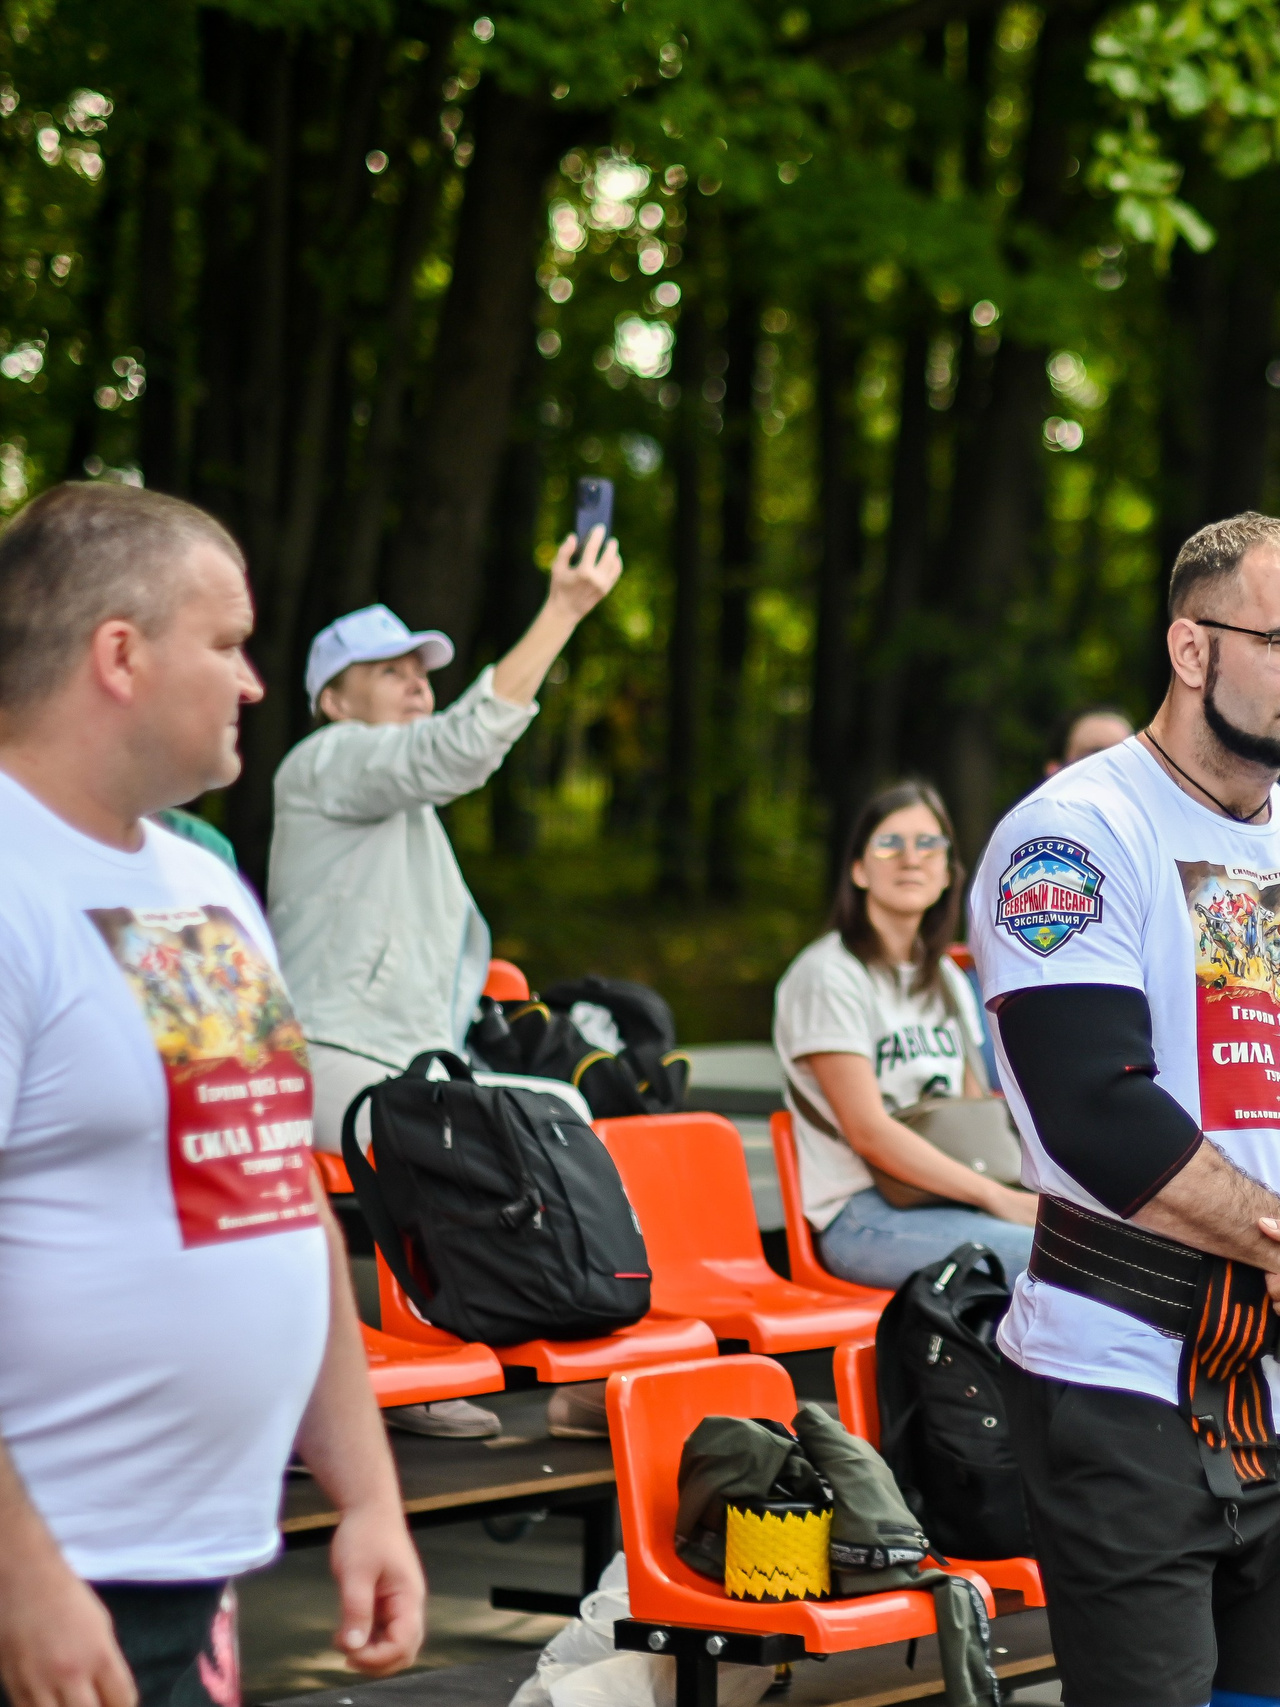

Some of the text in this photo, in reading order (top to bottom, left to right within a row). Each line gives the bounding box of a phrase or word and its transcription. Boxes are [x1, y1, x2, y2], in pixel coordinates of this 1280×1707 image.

[1020, 842, 1075, 857] РОССИЯ
[1004, 882, 1093, 917] СЕВЕРНЫЙ ДЕСАНТ
[1014, 913, 1080, 928] ЭКСПЕДИЦИЯ
[1211, 1041, 1275, 1066] СИЛА
[182, 1126, 254, 1164] СИЛА
